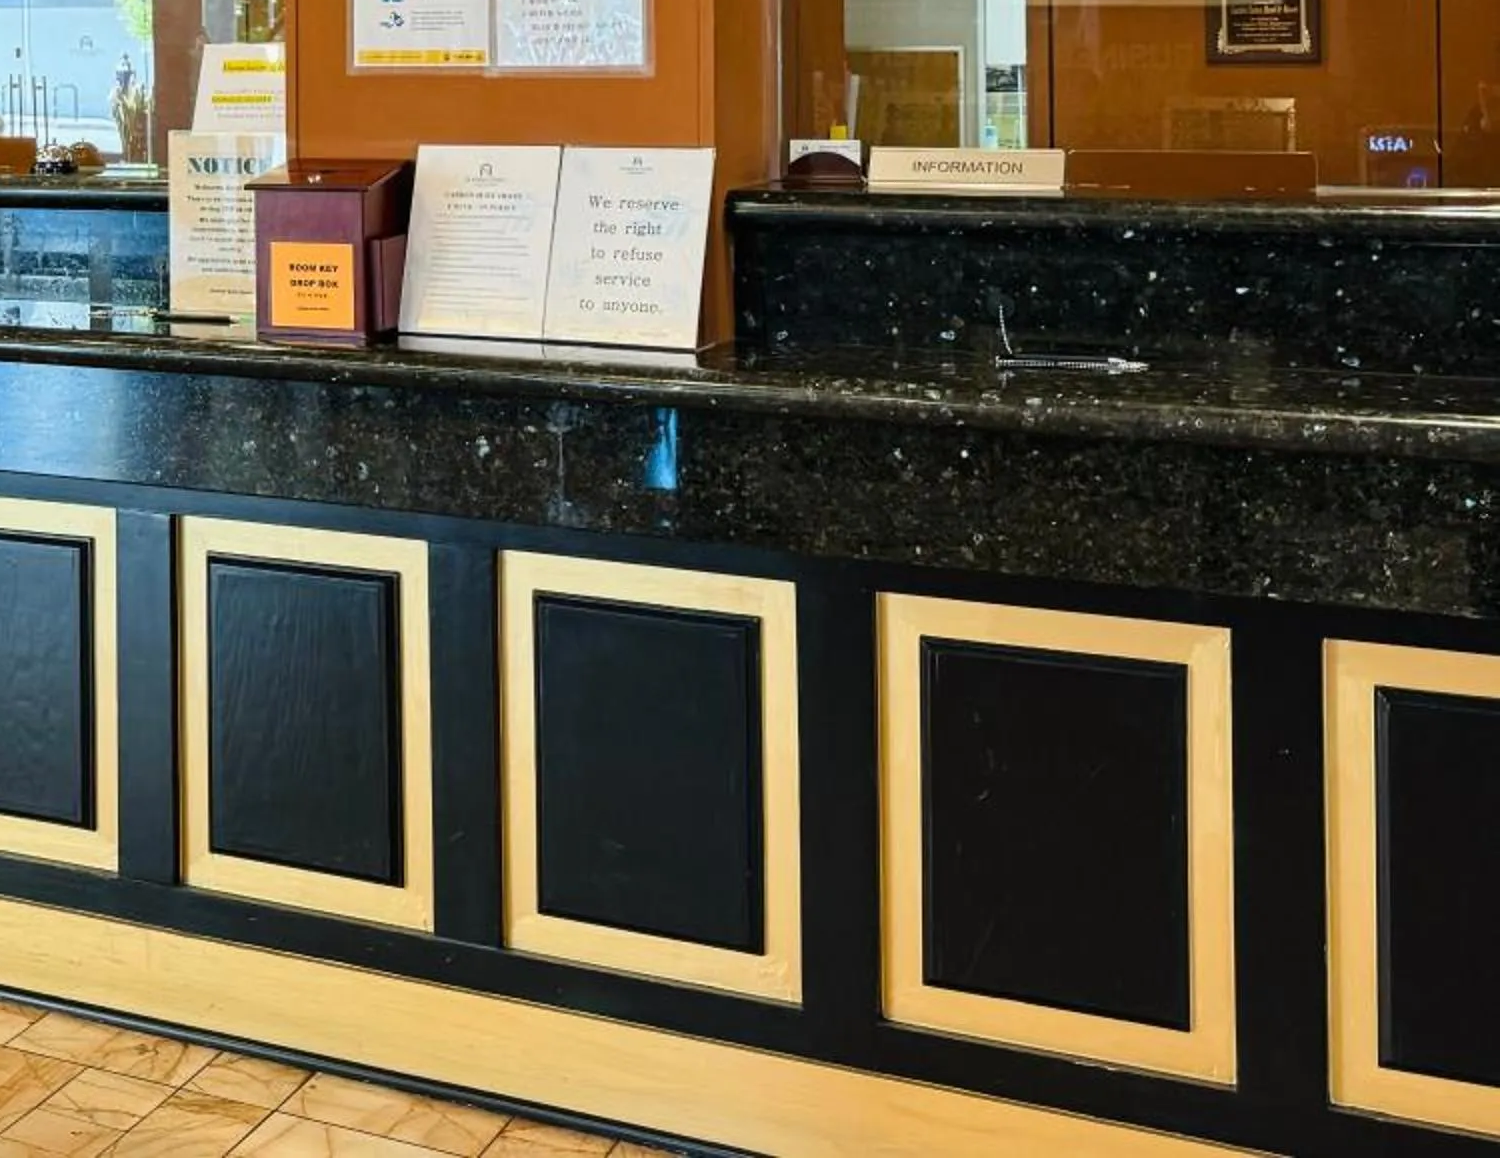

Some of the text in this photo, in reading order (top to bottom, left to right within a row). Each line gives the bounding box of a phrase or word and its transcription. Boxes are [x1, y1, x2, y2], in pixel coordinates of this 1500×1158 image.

[912, 161, 1024, 175] INFORMATION
[589, 195, 681, 211] We reserve
[593, 221, 662, 236] the right
[591, 247, 663, 261] to refuse
[595, 272, 651, 287] service
[580, 299, 595, 310] to
